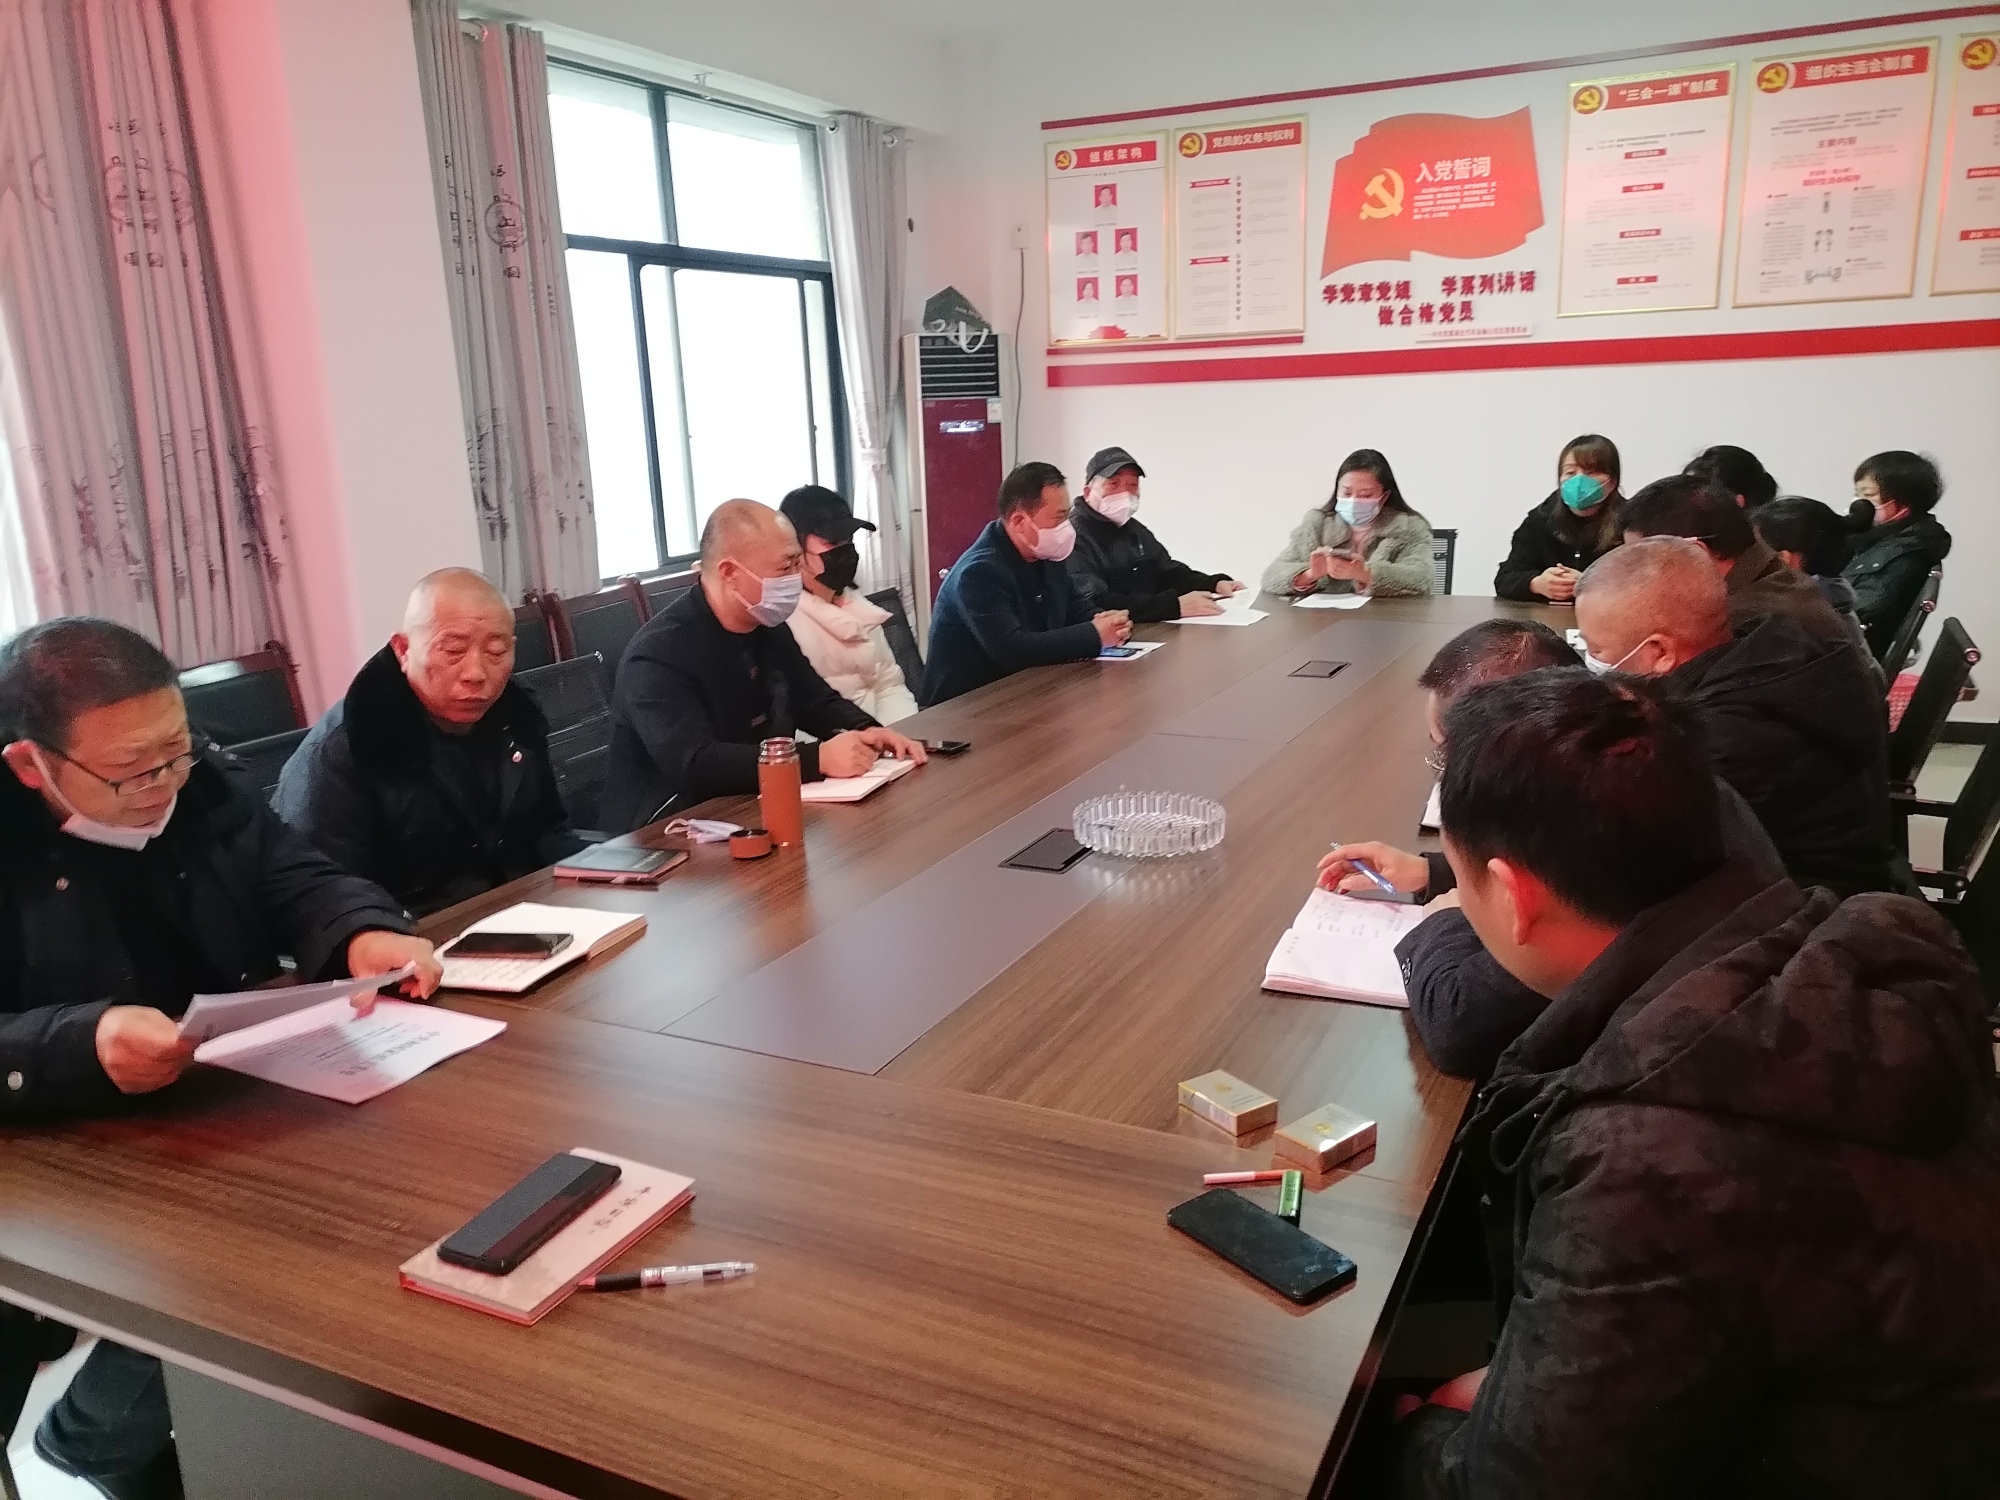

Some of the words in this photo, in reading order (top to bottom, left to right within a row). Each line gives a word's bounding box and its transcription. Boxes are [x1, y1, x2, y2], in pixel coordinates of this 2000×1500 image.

[1415, 156, 1491, 184] 入党誓词
[1441, 270, 1536, 297] 学系列讲话
[1378, 300, 1474, 326] 做合格党员
